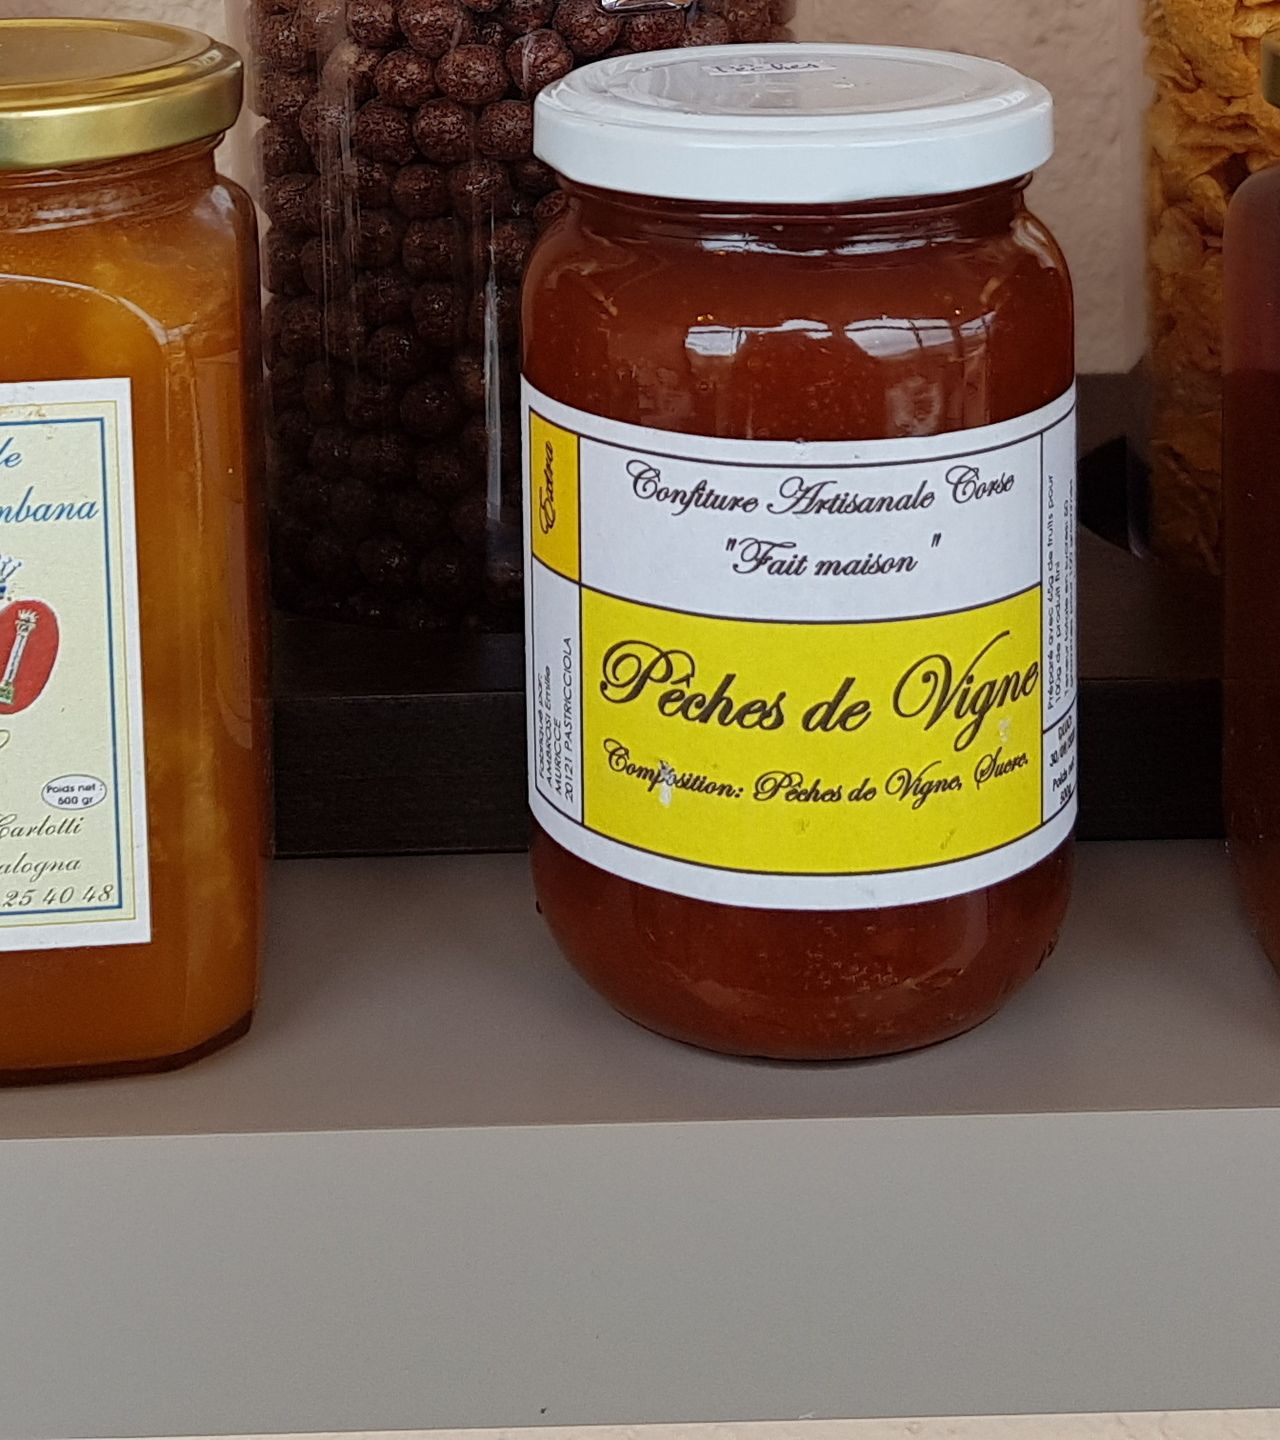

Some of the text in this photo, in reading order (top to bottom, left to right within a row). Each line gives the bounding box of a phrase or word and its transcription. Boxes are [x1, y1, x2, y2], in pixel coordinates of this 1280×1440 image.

[538, 440, 557, 535] Extra
[625, 458, 1016, 517] Confiture Artisanale Corse
[814, 553, 919, 579] maison
[562, 637, 574, 804] 20121 PASTRICCIOLA
[599, 638, 787, 733] Pêches
[801, 675, 872, 733] de
[891, 629, 1040, 753] Vigne
[544, 714, 553, 789] AMBROSI
[553, 716, 563, 797] MURICCE
[603, 737, 745, 800] Composition:
[753, 769, 843, 804] Pêches
[847, 778, 877, 804] de
[46, 785, 76, 794] Poids
[78, 783, 97, 793] net
[57, 795, 95, 808] 500 gr
[1, 888, 38, 909] 25
[42, 885, 75, 905] 40
[82, 883, 115, 904] 48
